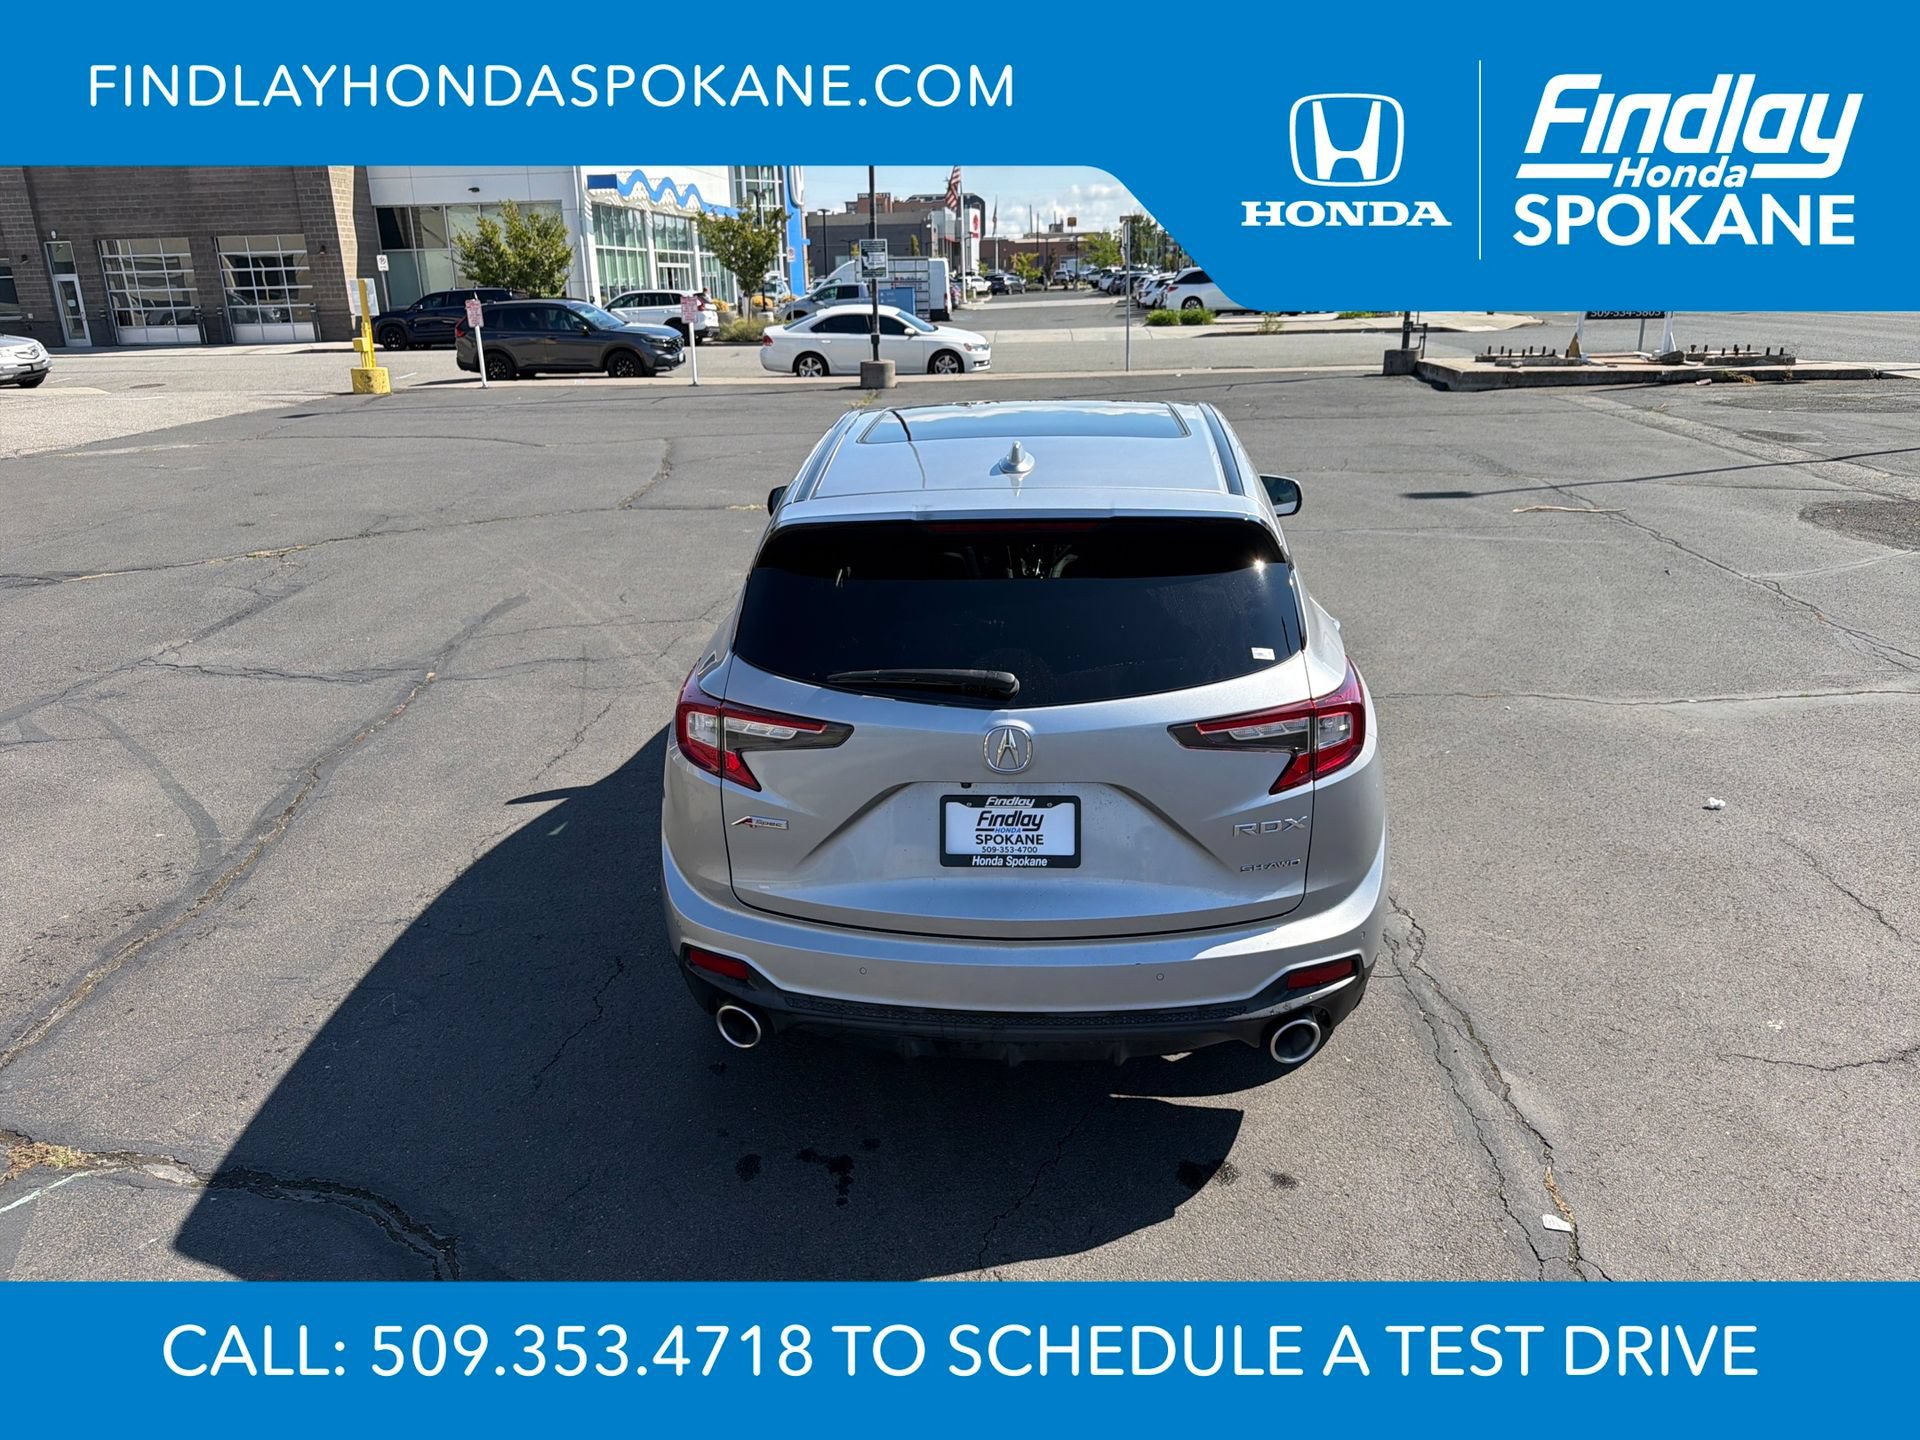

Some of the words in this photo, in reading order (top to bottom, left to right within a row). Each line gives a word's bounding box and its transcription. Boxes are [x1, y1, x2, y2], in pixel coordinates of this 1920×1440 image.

[986, 797, 1035, 807] Findlay
[976, 811, 1044, 831] Findlay
[1233, 815, 1308, 837] RDX
[975, 834, 1044, 845] SPOKANE
[972, 855, 1003, 866] Honda
[1006, 856, 1047, 867] Spokane
